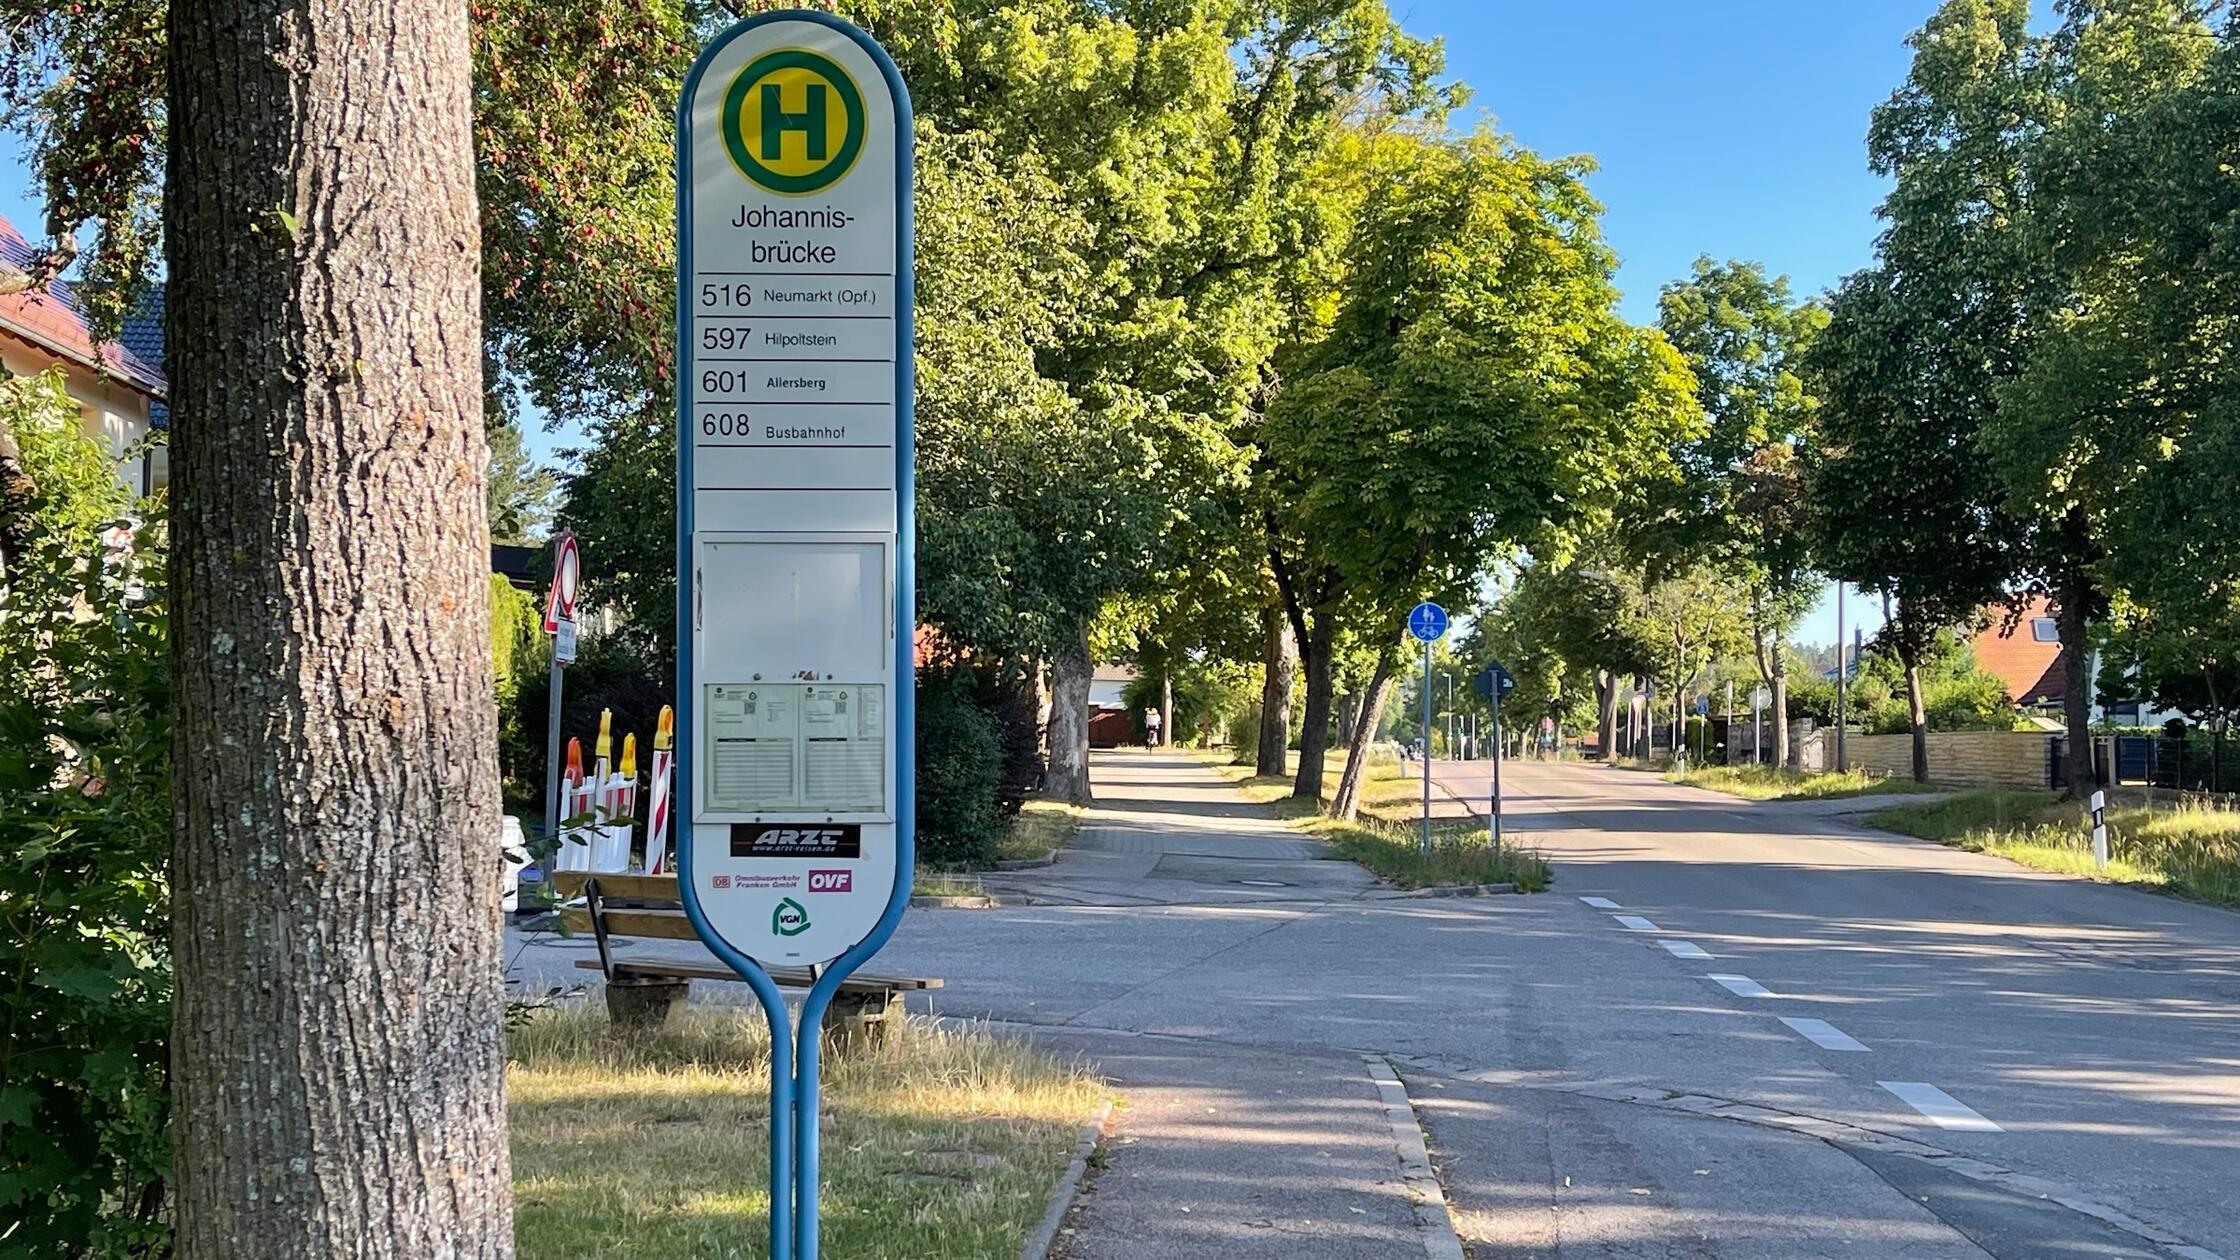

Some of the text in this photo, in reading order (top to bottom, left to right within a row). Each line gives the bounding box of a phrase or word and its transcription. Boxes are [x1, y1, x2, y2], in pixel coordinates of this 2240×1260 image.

[761, 83, 827, 160] H
[731, 204, 854, 228] Johannis-
[751, 240, 836, 264] brücke
[701, 283, 877, 307] 516 Neumarkt (Opf.)
[702, 327, 837, 350] 597 Hilpoltstein
[702, 370, 826, 393] 601 Allersberg
[702, 413, 846, 440] 608 Busbahnhof
[810, 873, 849, 889] OVF
[780, 915, 800, 924] VGN
